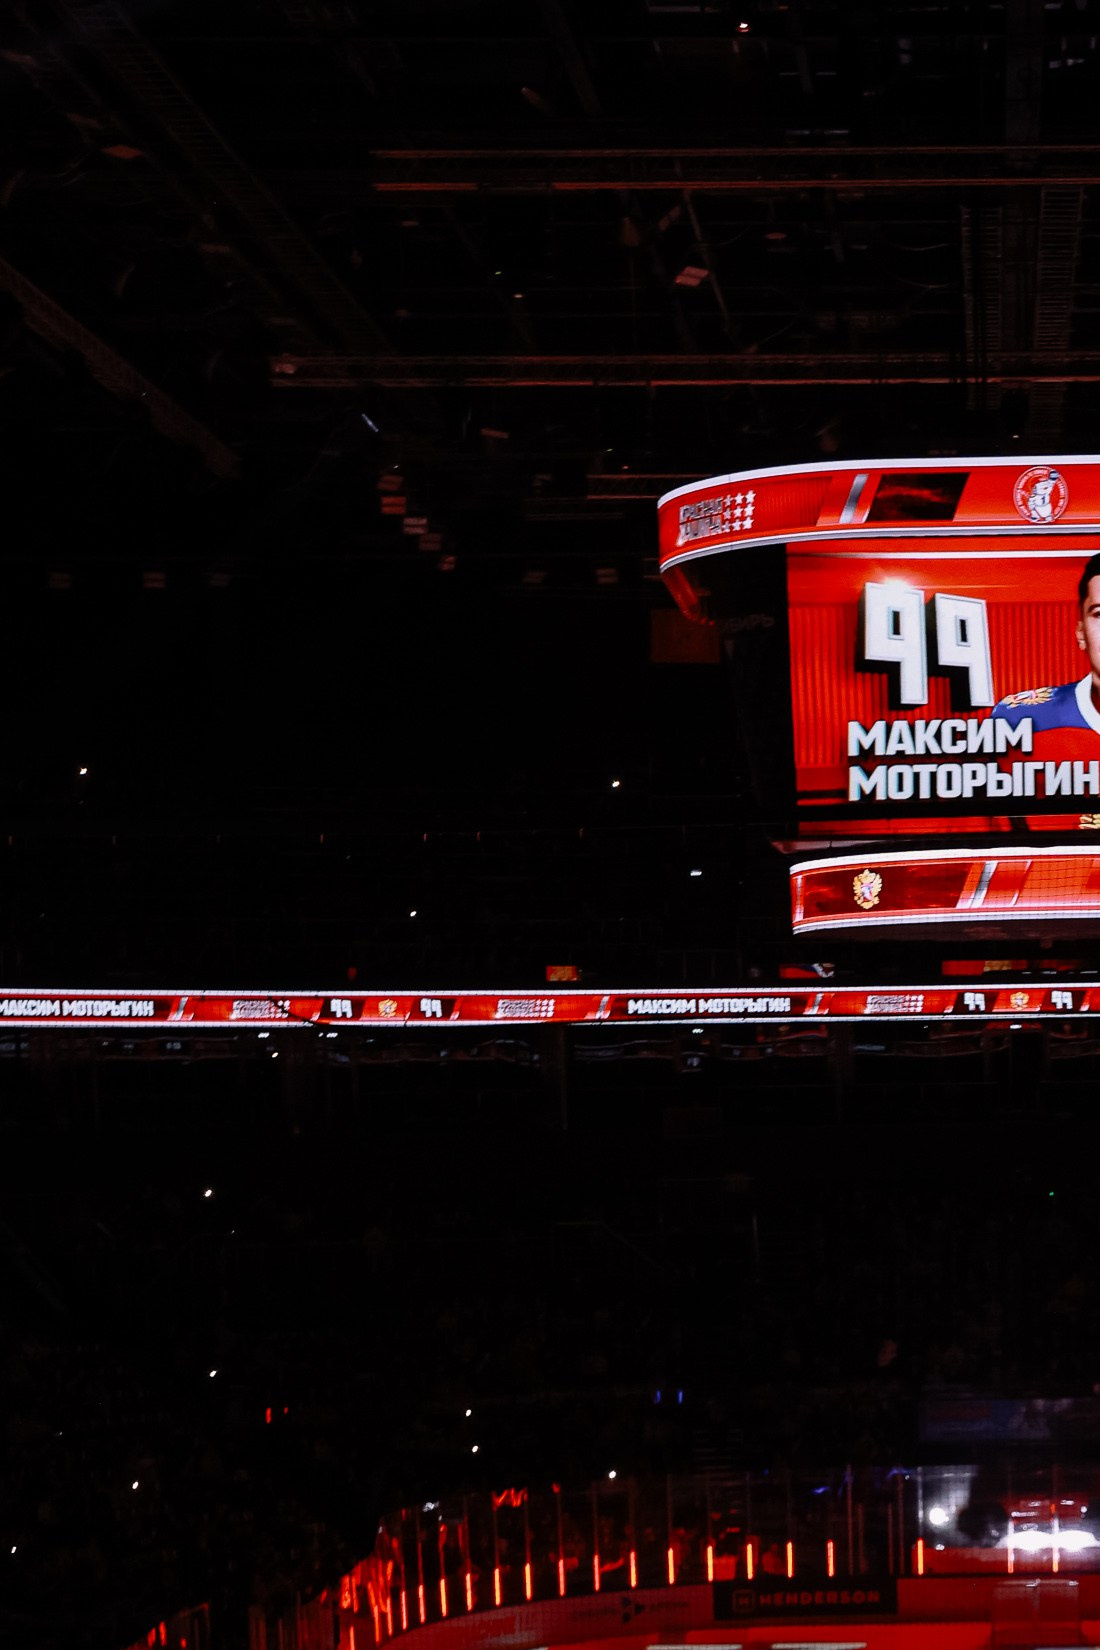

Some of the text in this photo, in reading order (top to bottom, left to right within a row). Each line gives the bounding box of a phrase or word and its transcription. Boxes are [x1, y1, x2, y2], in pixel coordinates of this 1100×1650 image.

[864, 582, 994, 706] 99
[847, 717, 1033, 757] МАКСИМ
[847, 760, 1100, 801] МОТОРЫГИН
[62, 999, 154, 1017] МОТОРЫГИН
[627, 996, 790, 1015] МАКСИМ МОТОРЫГИН
[759, 1590, 880, 1606] HENDERSON
